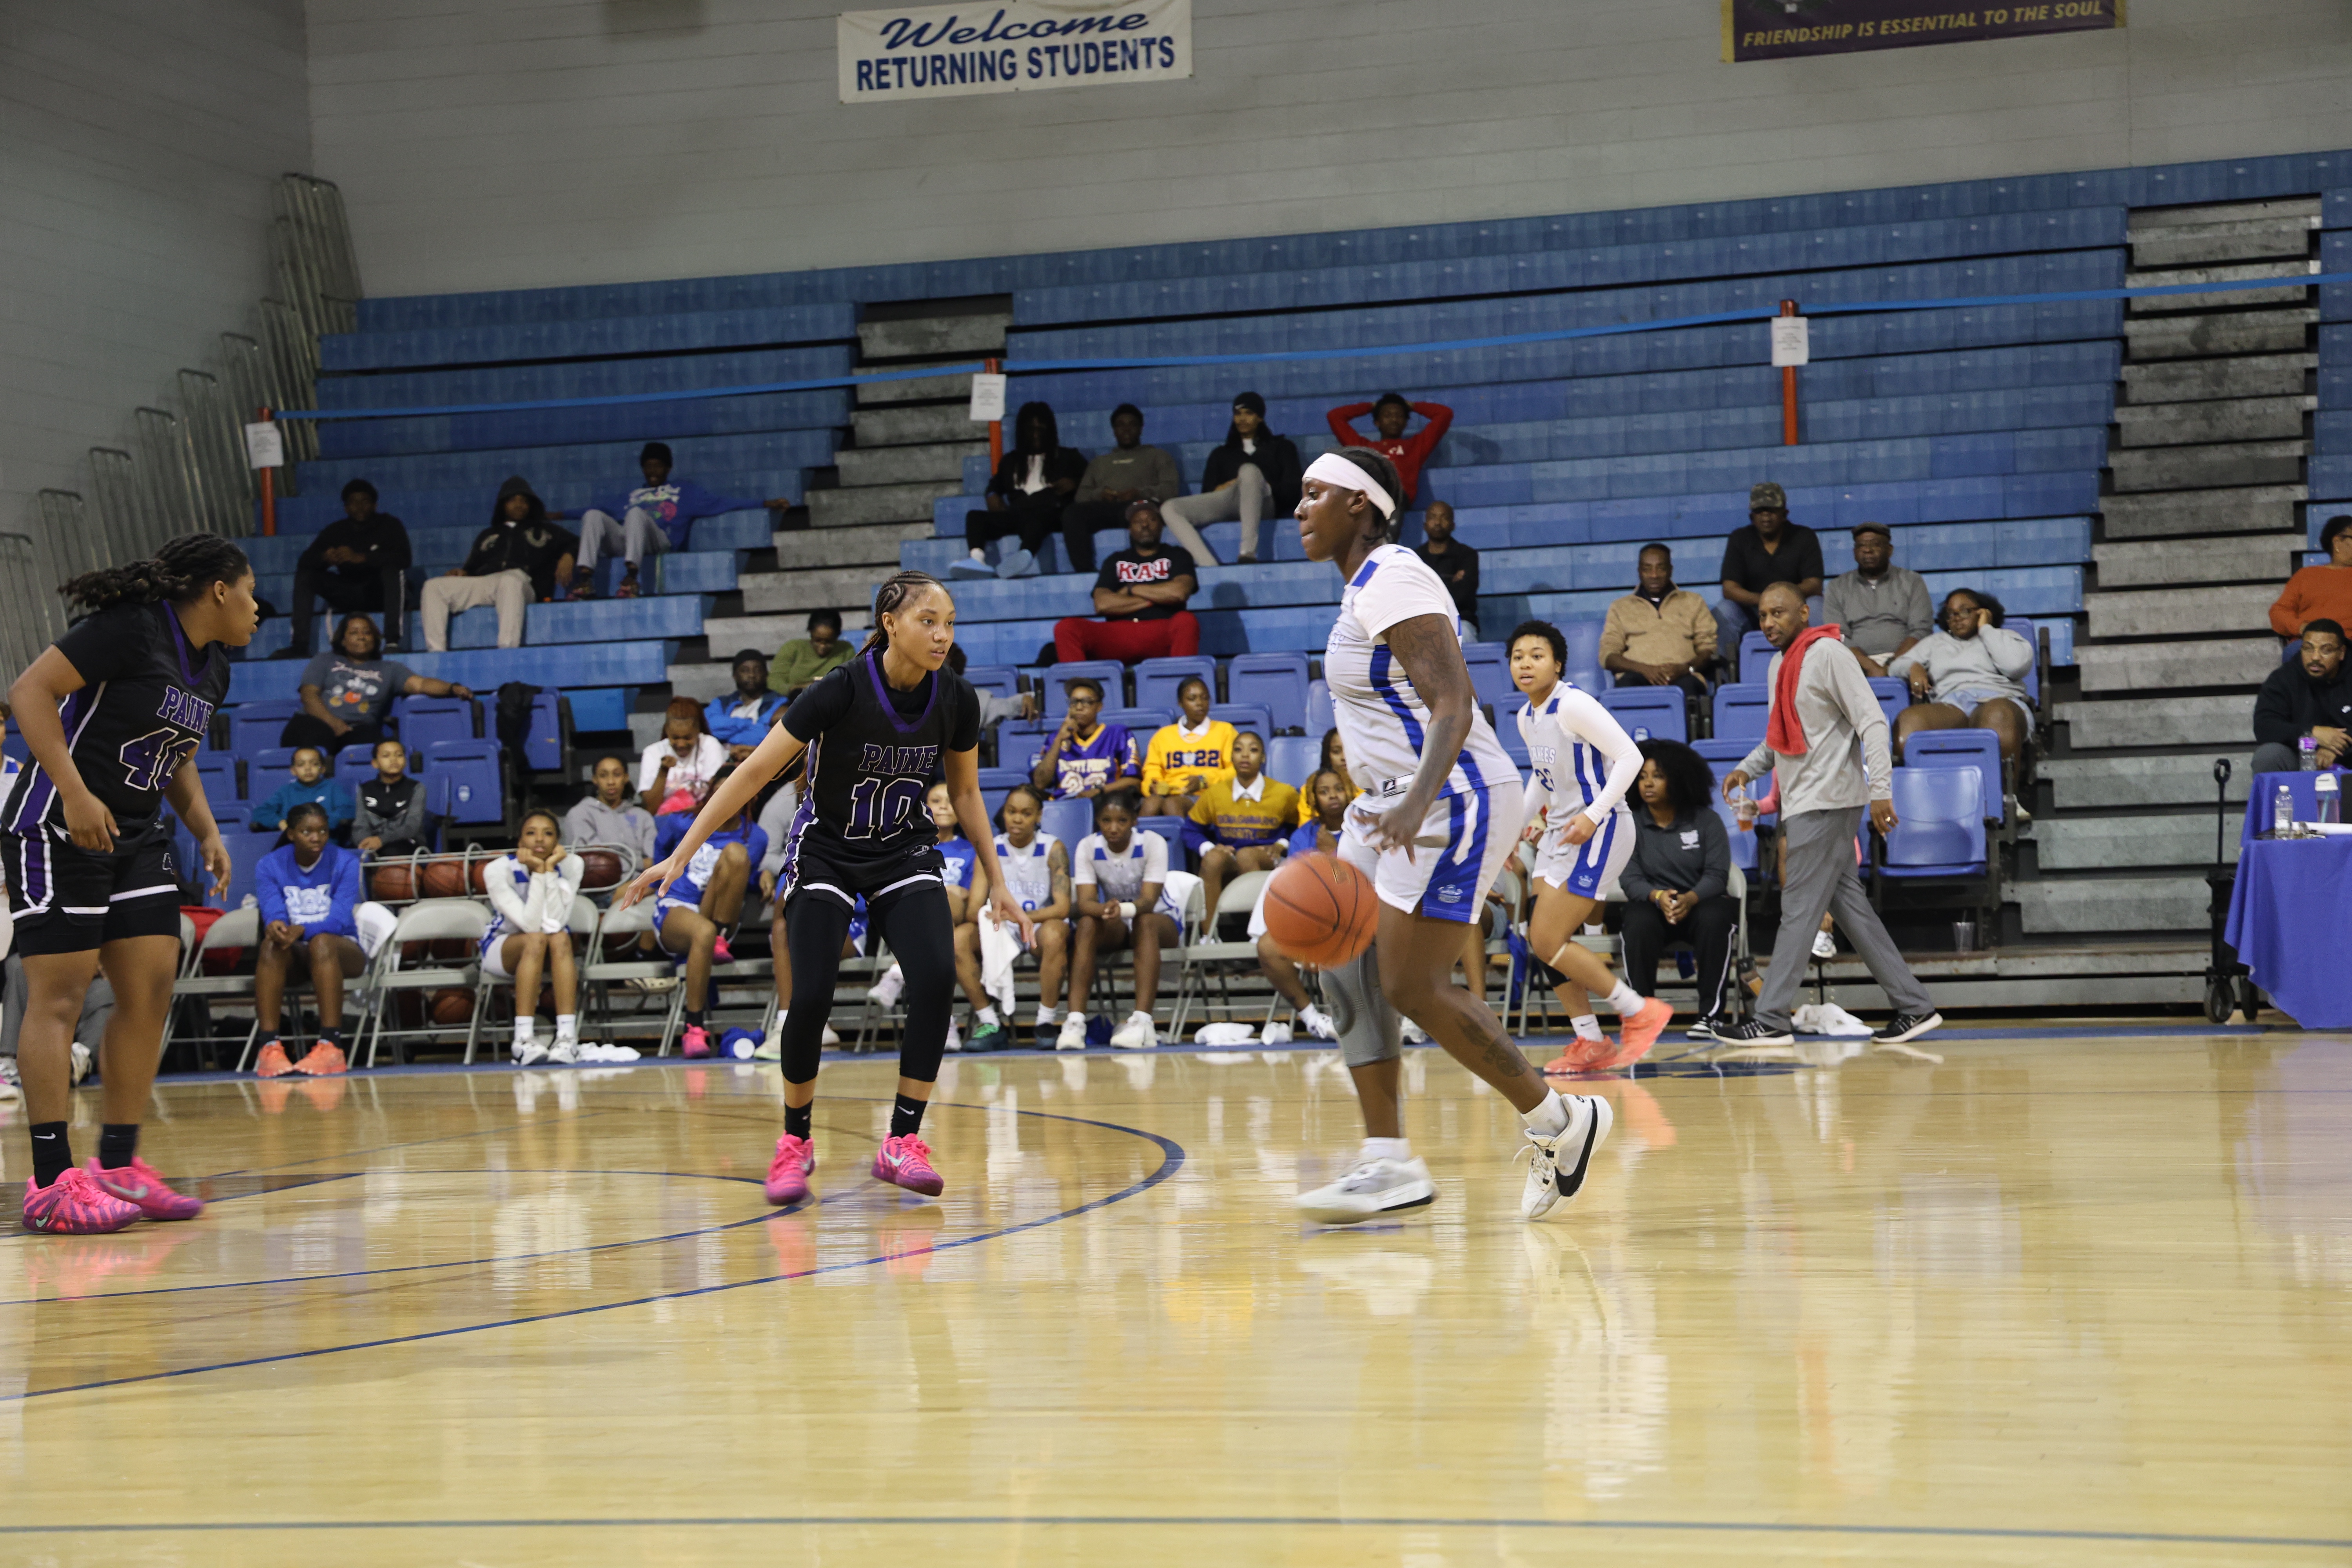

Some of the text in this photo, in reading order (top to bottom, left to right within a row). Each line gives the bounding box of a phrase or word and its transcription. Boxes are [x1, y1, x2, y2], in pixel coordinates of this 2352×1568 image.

[880, 9, 1149, 50] Welcome
[1743, 0, 2103, 47] FRIENDSHIP IS ESSENTIAL TO THE SOUL
[857, 36, 1174, 91] RETURNING STUDENTS
[156, 685, 214, 735] PAINE
[858, 743, 938, 775] PAINE
[844, 777, 924, 841] 10
